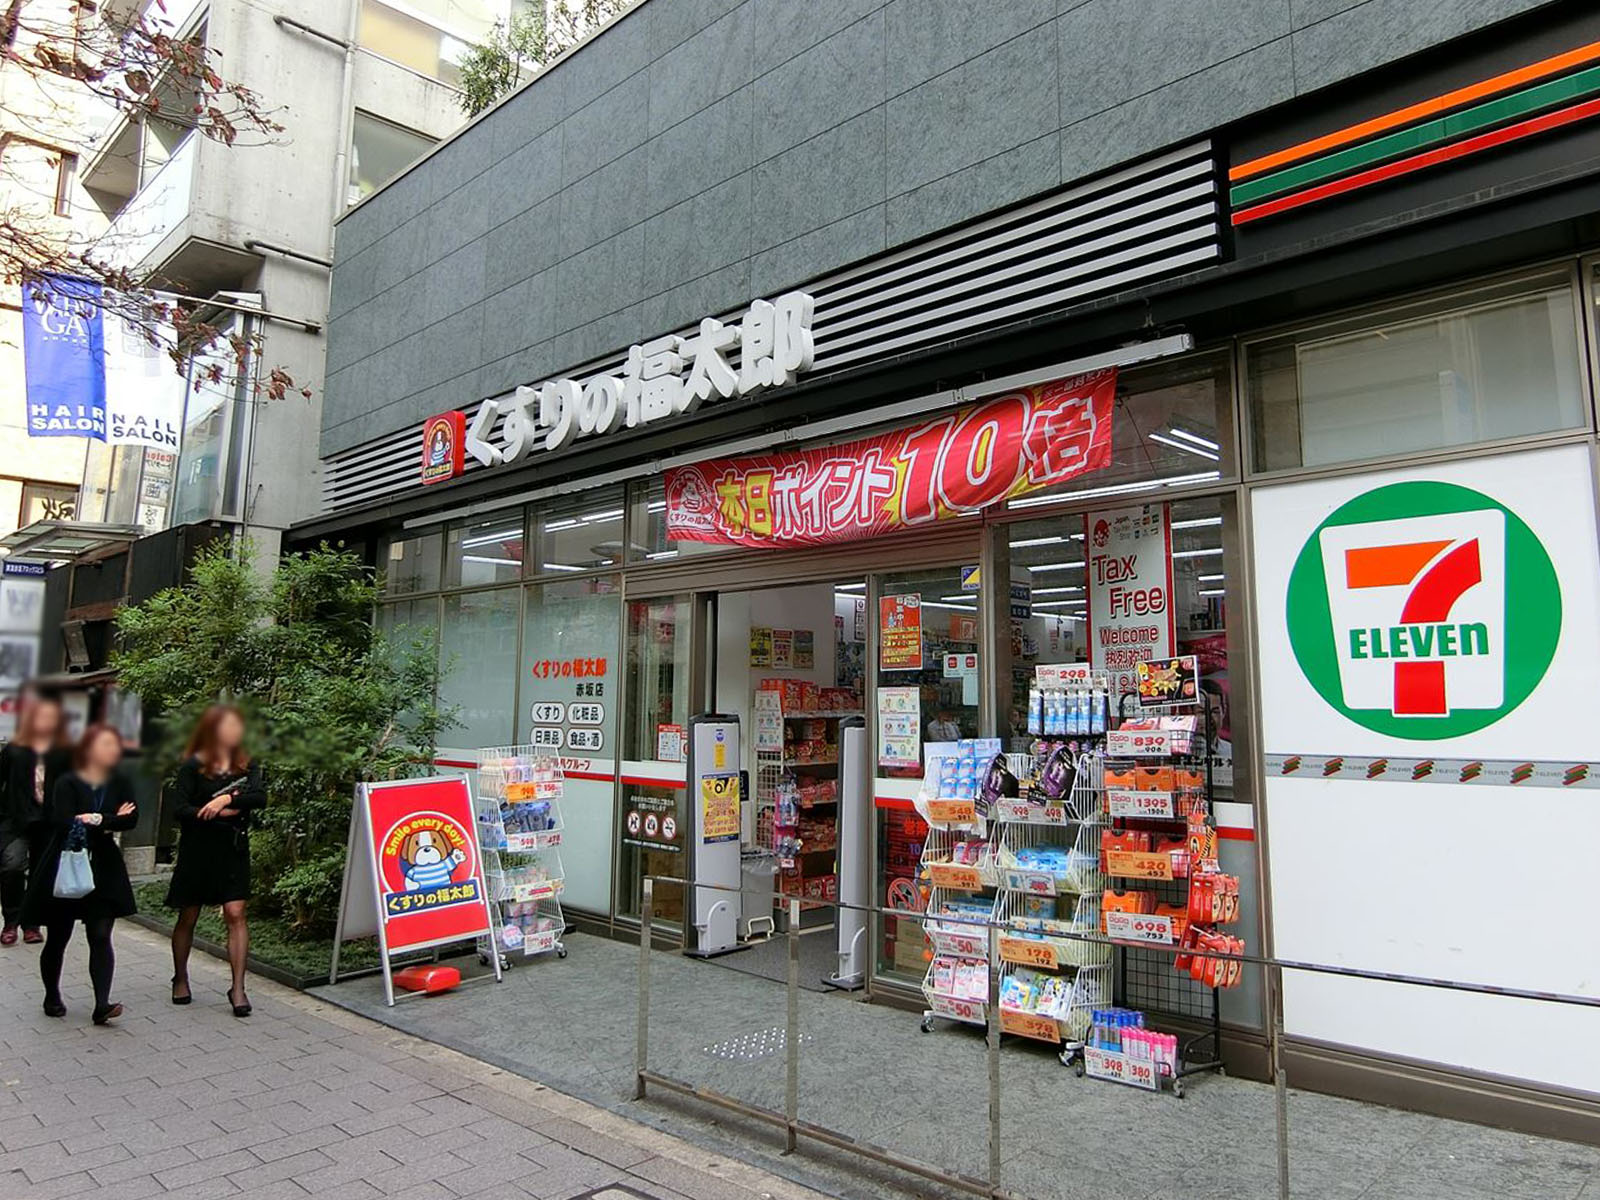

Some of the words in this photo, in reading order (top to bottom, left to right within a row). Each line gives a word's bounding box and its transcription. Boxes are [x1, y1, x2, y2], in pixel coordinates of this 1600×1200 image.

[465, 291, 814, 466] くすりの福太郎
[31, 403, 104, 420] HAIR
[31, 417, 104, 435] SALON
[112, 413, 177, 434] NAIL
[112, 426, 177, 446] SALON
[1092, 554, 1137, 585] Tax
[1110, 587, 1165, 619] Free
[1345, 537, 1482, 714] 7
[1100, 625, 1159, 647] Welcome
[532, 658, 607, 678] くすりの福太郎
[1060, 669, 1086, 679] 298
[576, 683, 604, 697] 赤坂店
[536, 706, 560, 720] くすり
[572, 707, 599, 721] 化粧品
[536, 731, 559, 744] 日用品
[1135, 737, 1165, 746] 839
[1136, 798, 1168, 807] 1395
[386, 826, 411, 856] Smile
[411, 818, 444, 831] every
[443, 824, 466, 846] day!
[1136, 861, 1166, 870] 420
[389, 884, 475, 910] くすりの福太郎
[1135, 922, 1166, 932] 698
[957, 940, 973, 953] 50
[955, 1003, 971, 1017] 50
[1104, 1058, 1123, 1072] 398
[1131, 1064, 1150, 1078] 380
